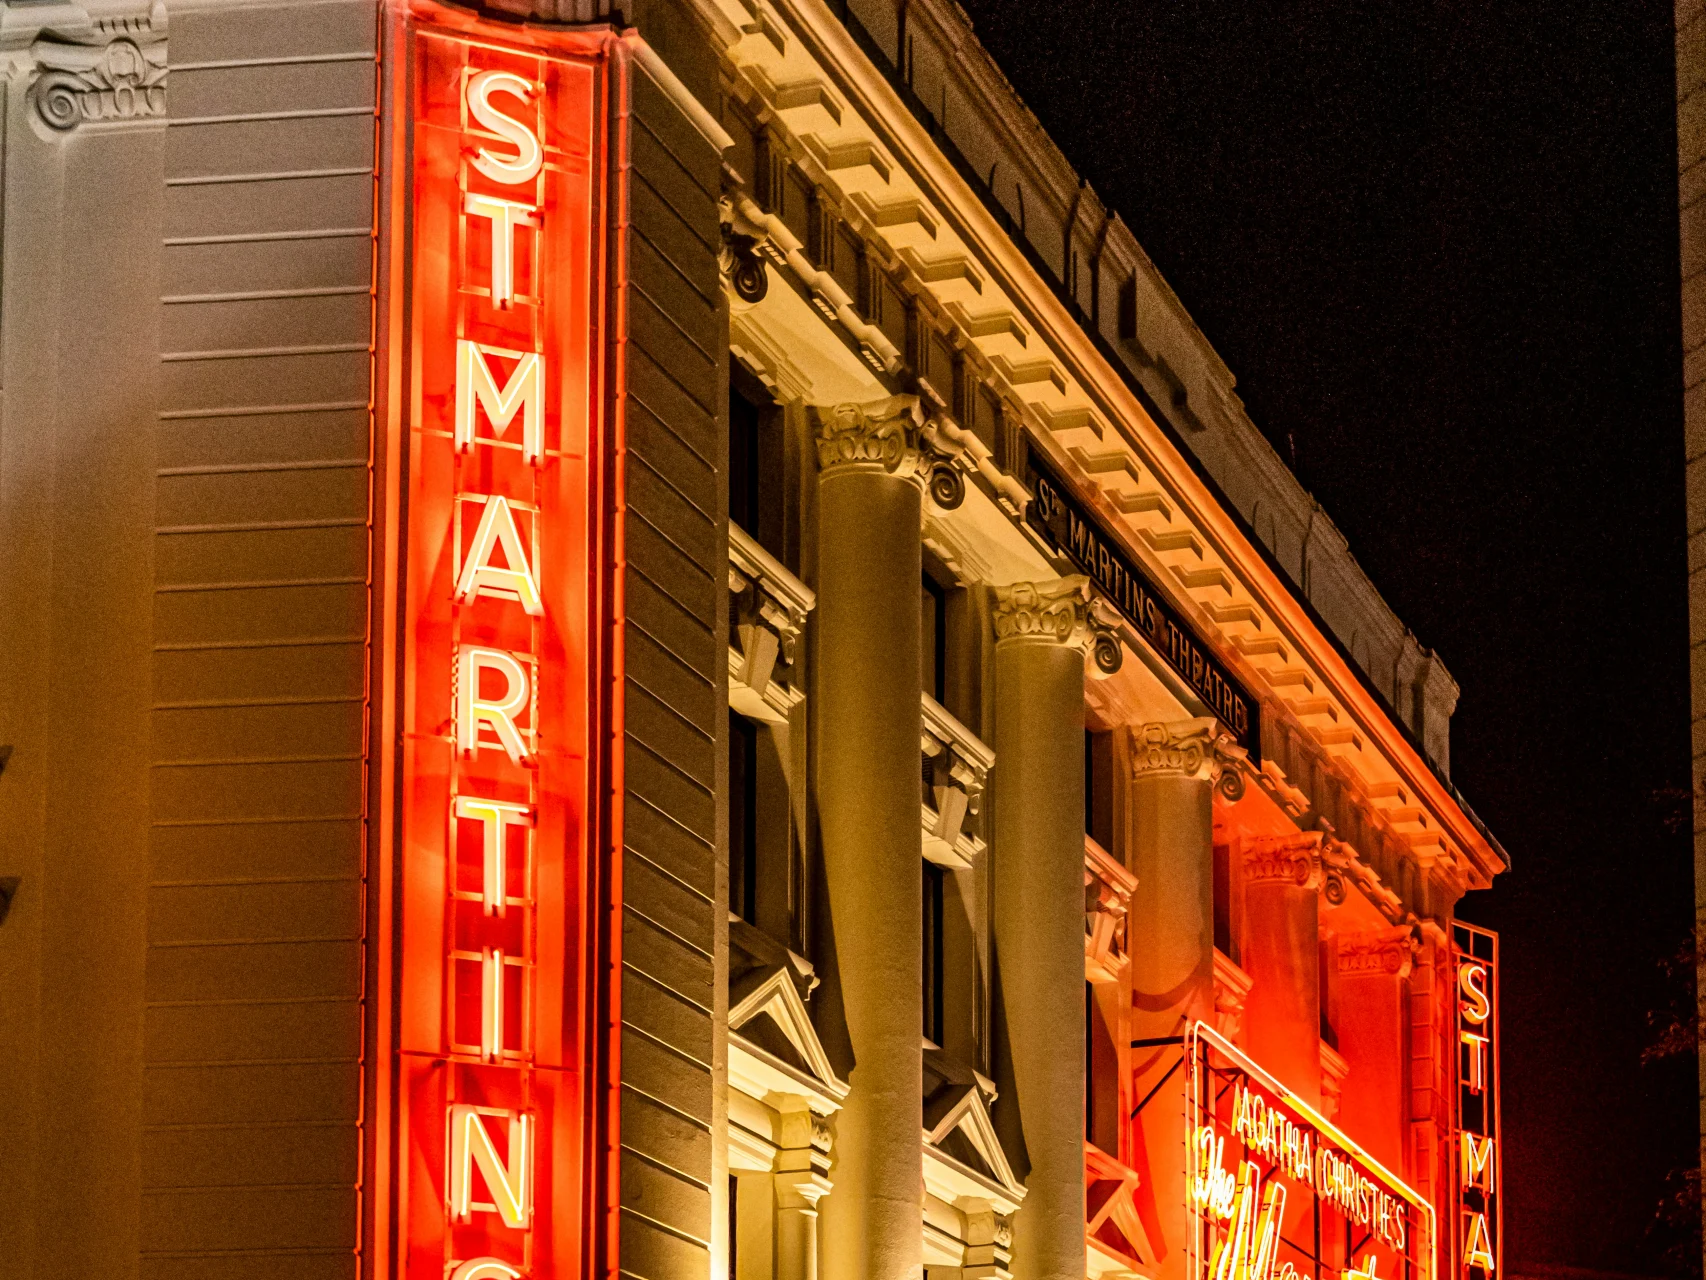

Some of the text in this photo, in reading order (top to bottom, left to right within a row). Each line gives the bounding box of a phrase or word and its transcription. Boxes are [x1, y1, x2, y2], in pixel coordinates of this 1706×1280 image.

[1167, 620, 1247, 732] THEATRE
[1191, 1126, 1236, 1220] The
[1234, 1086, 1405, 1250] AGATHA CHRISTIE'S
